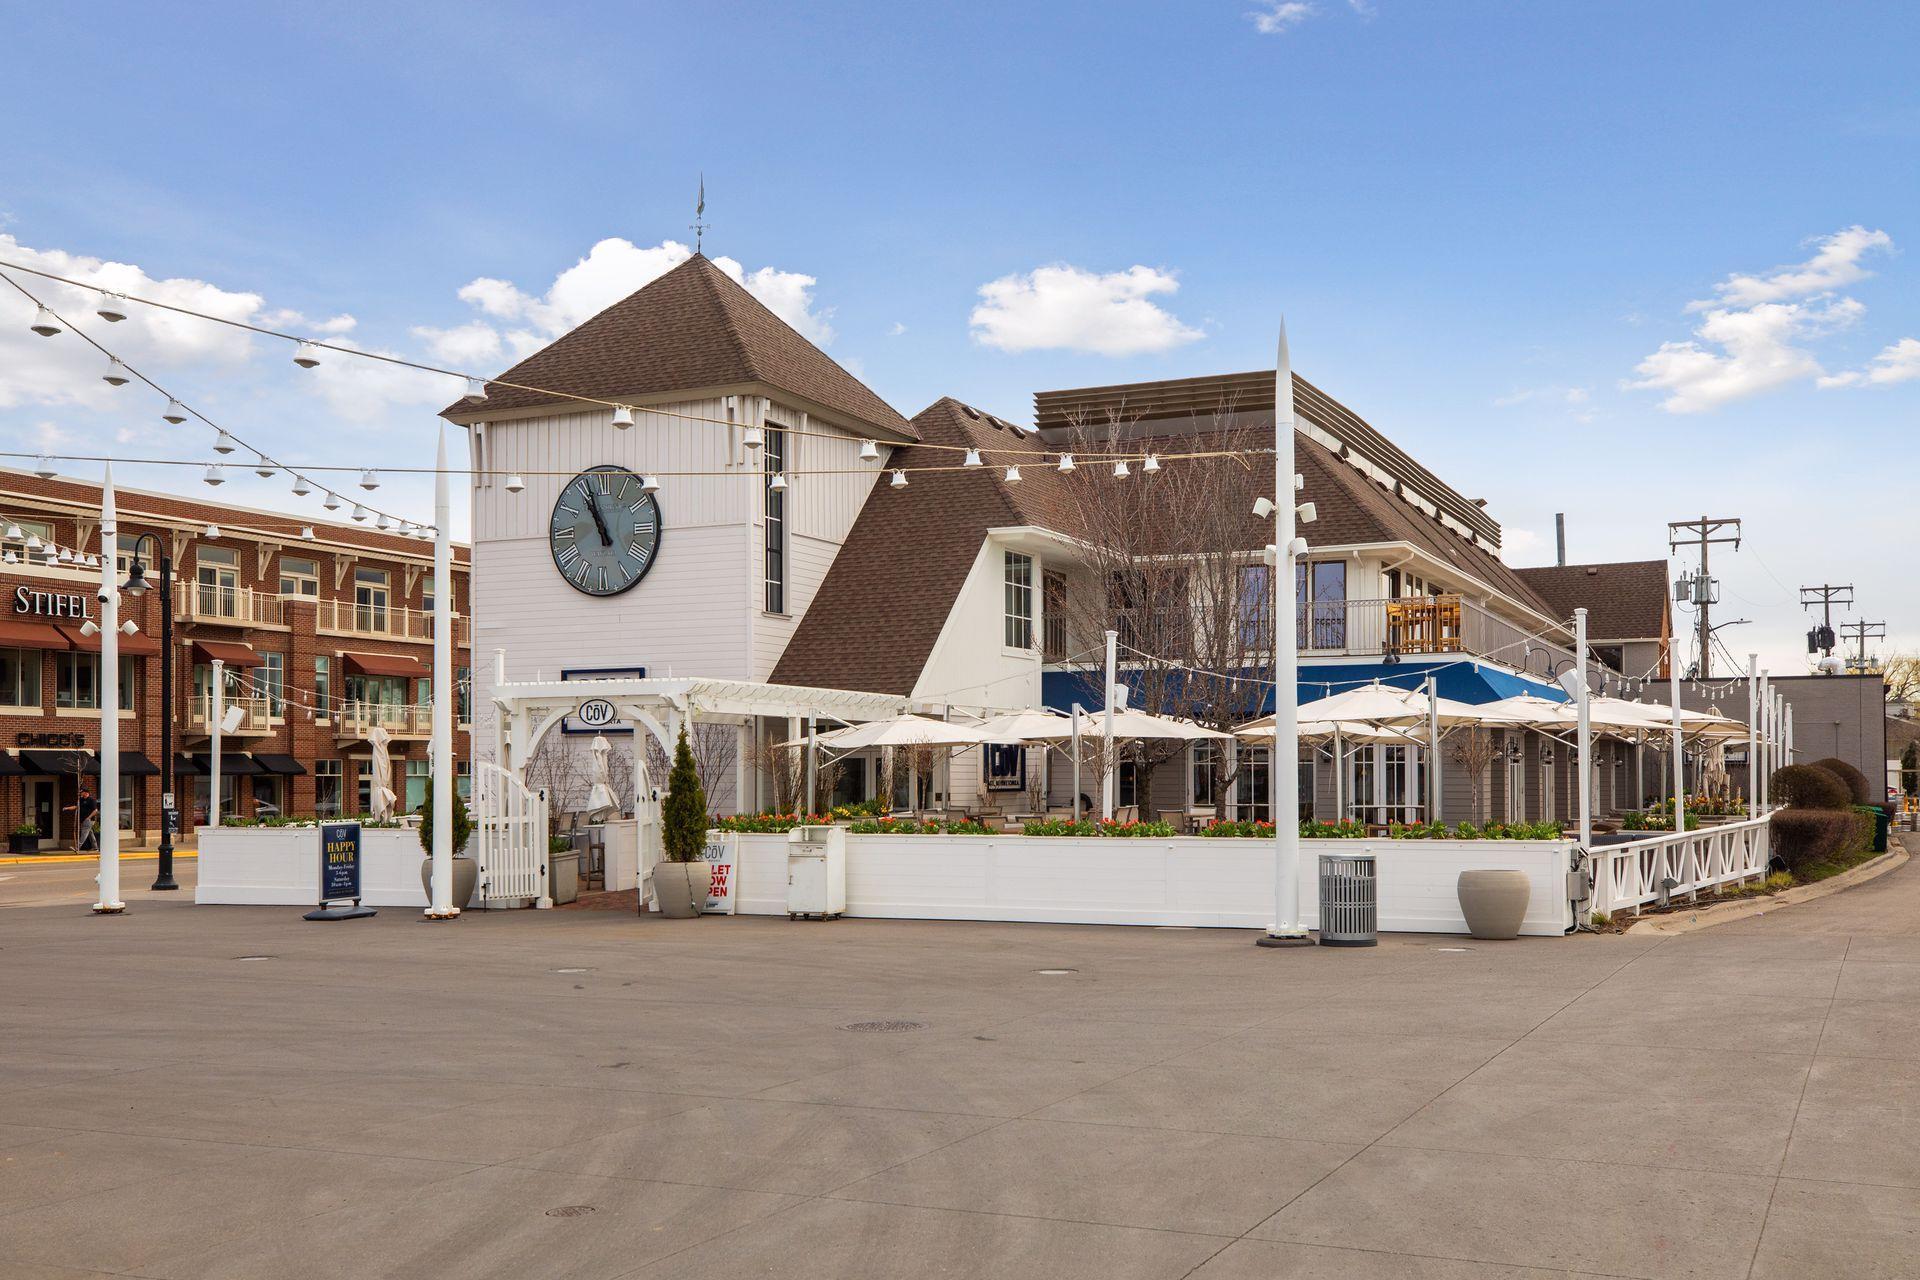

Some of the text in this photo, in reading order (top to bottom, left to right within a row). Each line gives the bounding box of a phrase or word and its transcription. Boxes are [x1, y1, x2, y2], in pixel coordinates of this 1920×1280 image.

[634, 522, 654, 534] III
[16, 586, 95, 619] STIFEL
[327, 841, 355, 853] HAPPY
[329, 852, 354, 863] HOUR
[711, 864, 731, 875] LET
[708, 886, 727, 897] PEN
